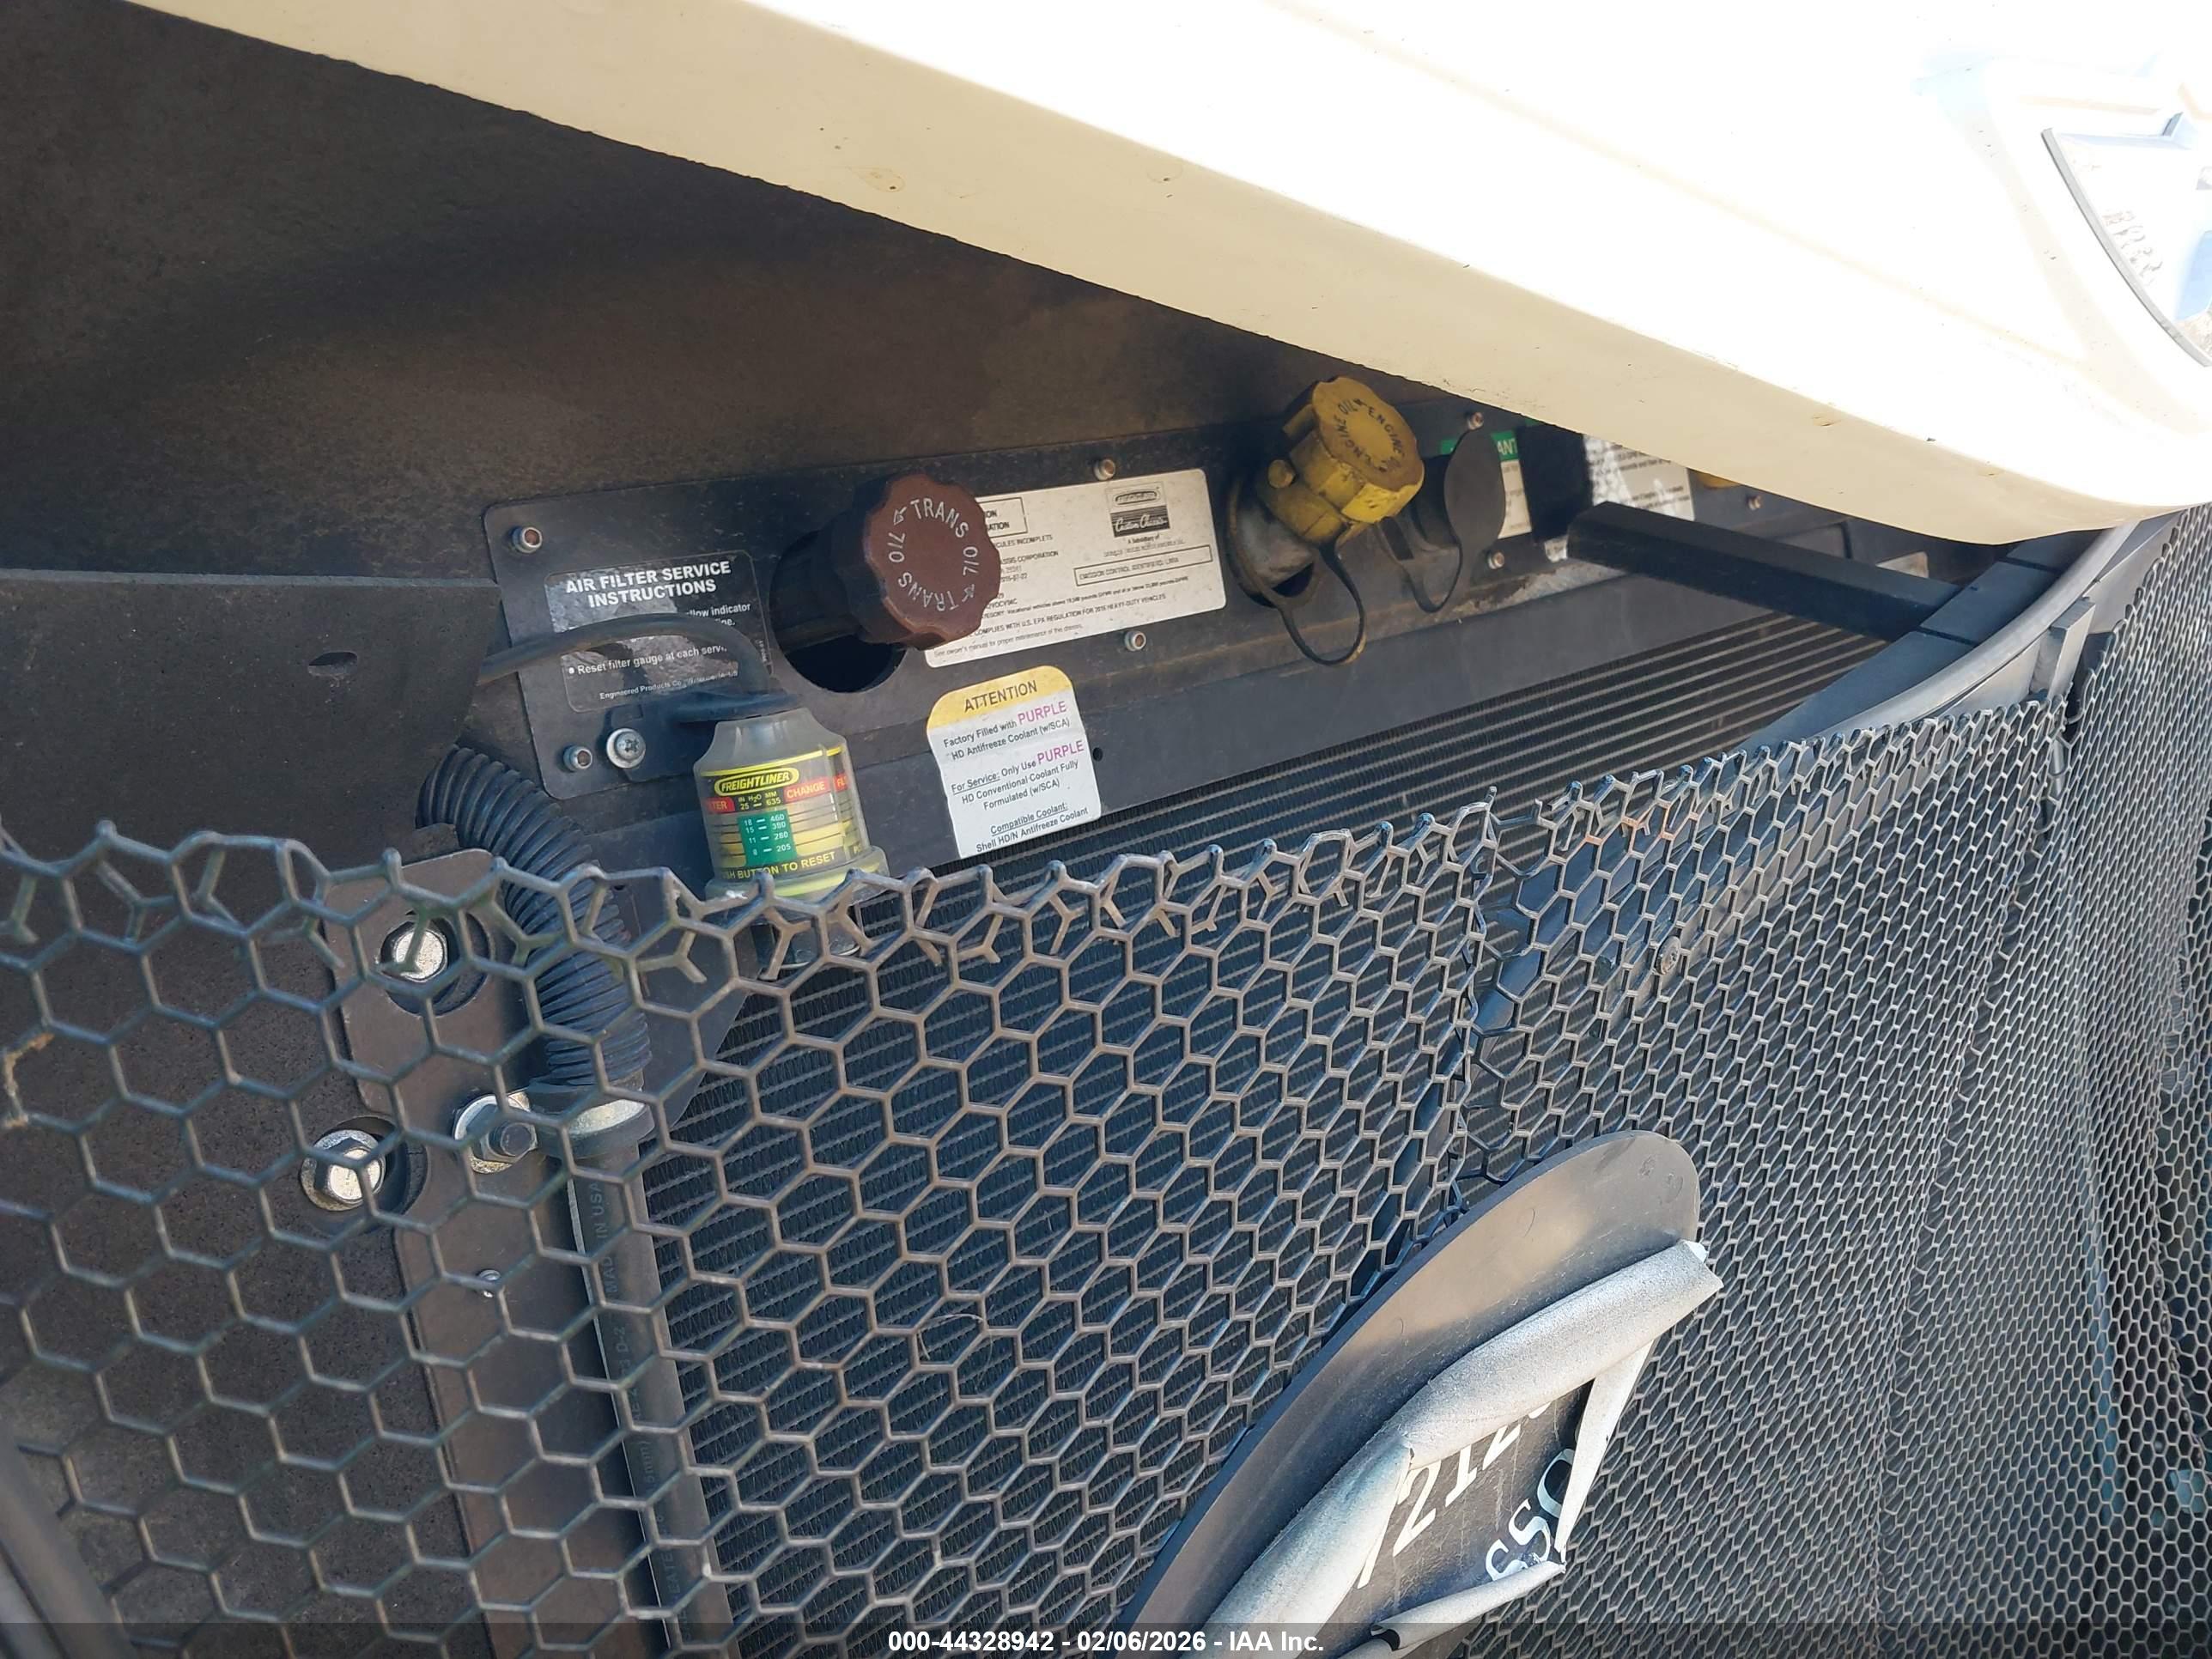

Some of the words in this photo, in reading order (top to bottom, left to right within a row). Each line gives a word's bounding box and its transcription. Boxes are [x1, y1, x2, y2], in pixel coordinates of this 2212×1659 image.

[910, 497, 969, 538] TRANS
[963, 546, 980, 576] OIL
[988, 521, 1010, 531] ATION
[887, 532, 906, 563] OIL
[566, 576, 597, 594] AIR
[601, 569, 659, 589] FILTER
[662, 561, 732, 582] SERVICE
[897, 572, 959, 611] TRANS
[588, 579, 717, 608] INSTRUCTIONS
[711, 603, 751, 617] indicator
[974, 625, 1006, 637] COMPLIES
[577, 661, 607, 675] Reset
[608, 657, 631, 672] filter
[633, 652, 664, 669] gauge
[665, 651, 676, 661] at
[677, 647, 700, 660] each
[963, 679, 1038, 713] ATTENTION
[943, 729, 975, 749] Factory
[976, 724, 999, 740] Filled
[999, 720, 1018, 732] with
[1018, 701, 1067, 726] PURPLE
[951, 749, 966, 762] HD
[967, 738, 1007, 757] Antifreeze
[1007, 727, 1038, 744] Coolant
[1039, 716, 1070, 737] (w/SCA)
[951, 781, 965, 793] For
[966, 771, 1000, 789] Service:
[1000, 763, 1020, 778] Only
[1020, 759, 1037, 772] Use
[1036, 739, 1085, 765] PURPLE
[961, 793, 975, 805] HD
[975, 775, 1029, 800] Conventional
[1029, 764, 1060, 782] Coolant
[1060, 758, 1079, 774] Fully
[720, 771, 790, 793] FREIGHTLINER
[786, 781, 826, 799] CHANGE
[982, 788, 1029, 811] Formulated
[1029, 776, 1060, 798] (w/SCA)
[712, 800, 728, 811] TER
[740, 803, 750, 811] 25
[766, 797, 781, 805] 635
[989, 812, 1036, 836] Compatible
[1035, 800, 1069, 820] Coolant:
[744, 818, 753, 827] 18
[770, 813, 785, 823] 460
[745, 826, 755, 835] 15
[975, 837, 998, 854] Shell
[998, 830, 1019, 846] HD/N
[1019, 819, 1060, 839] Antifreeze
[1059, 805, 1089, 824] Coolant
[748, 836, 757, 844] 11
[775, 842, 791, 853] 205
[781, 861, 798, 873] TO
[800, 850, 836, 869] RESET
[589, 1182, 605, 1216] USA
[604, 1256, 618, 1293] MAD
